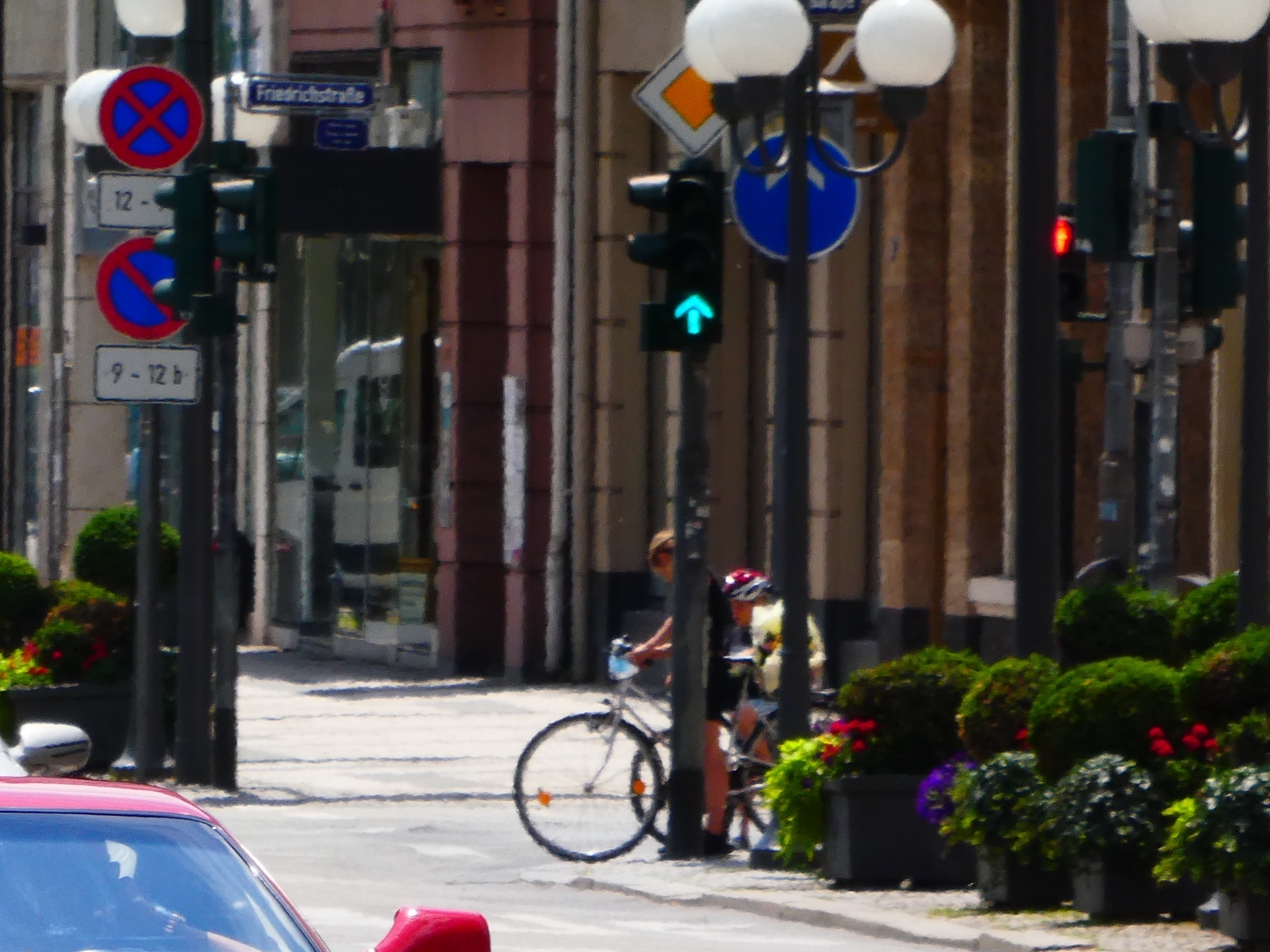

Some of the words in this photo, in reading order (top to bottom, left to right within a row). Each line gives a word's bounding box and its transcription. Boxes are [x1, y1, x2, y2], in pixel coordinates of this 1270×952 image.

[256, 83, 365, 104] Friedrichstraße
[115, 190, 132, 211] 12
[112, 362, 123, 384] 9
[149, 364, 166, 385] 12
[174, 364, 183, 385] h
